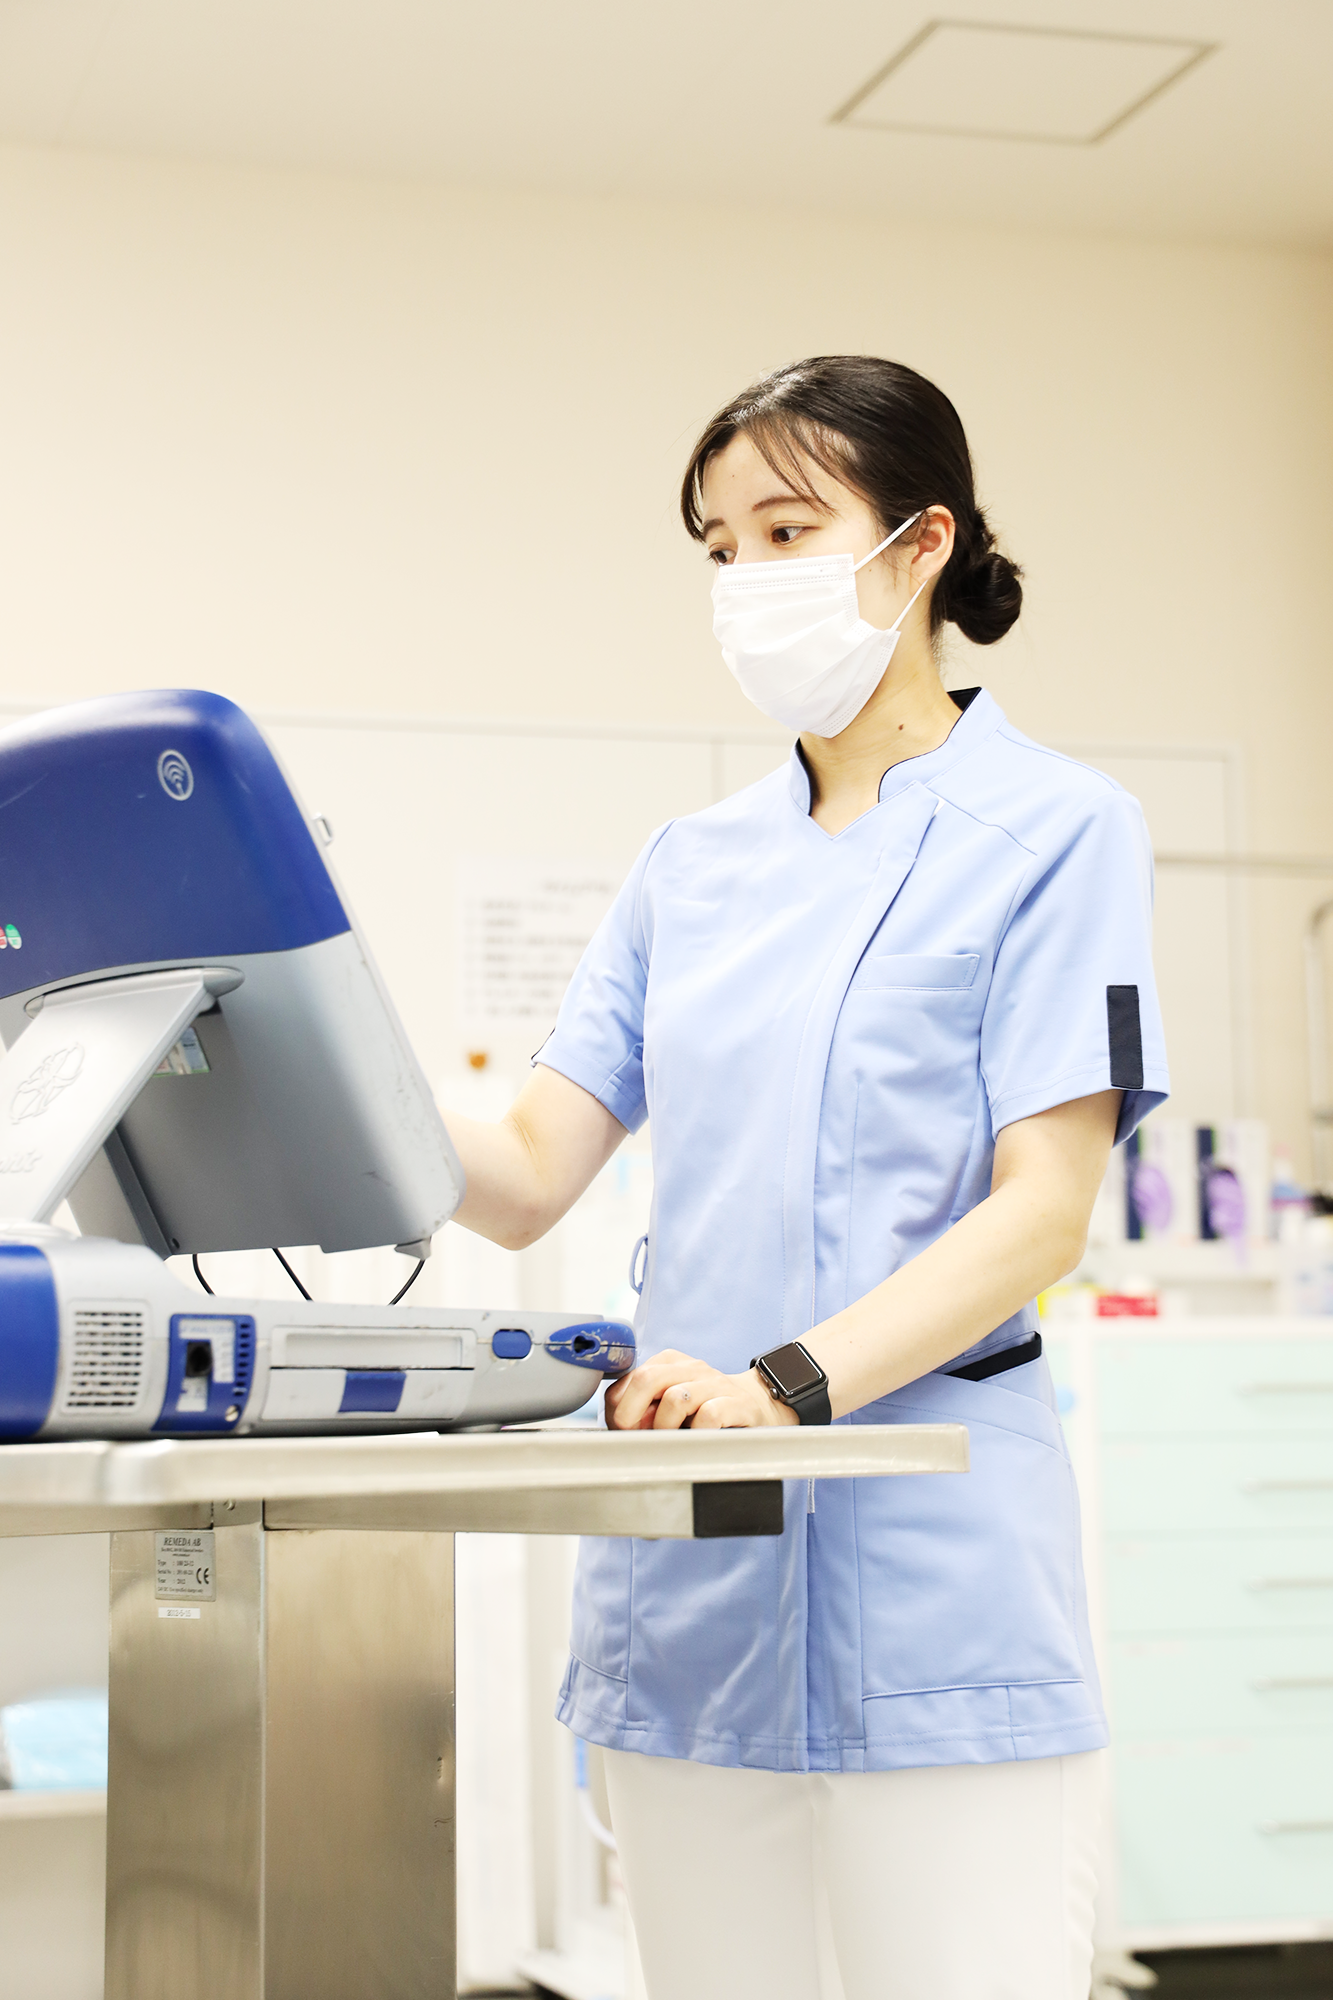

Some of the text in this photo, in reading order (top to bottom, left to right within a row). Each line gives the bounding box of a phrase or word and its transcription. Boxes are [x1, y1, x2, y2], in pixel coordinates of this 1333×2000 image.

[164, 1537, 202, 1547] REMEDA AB
[197, 1567, 210, 1585] CE
